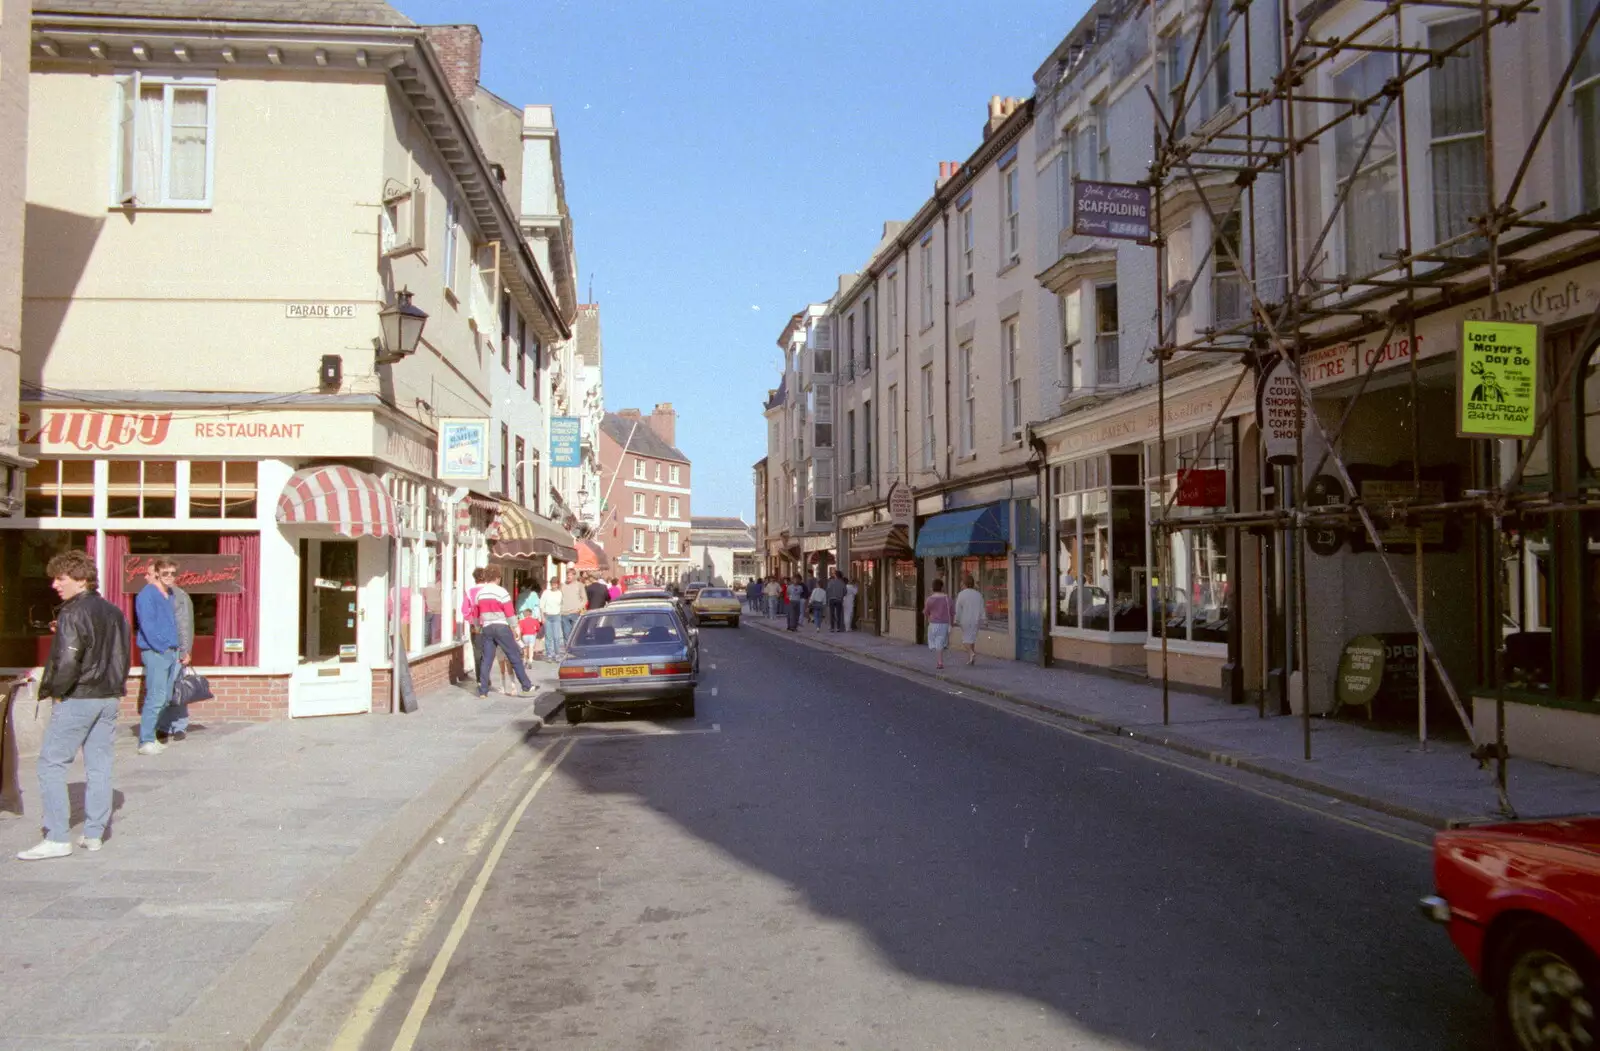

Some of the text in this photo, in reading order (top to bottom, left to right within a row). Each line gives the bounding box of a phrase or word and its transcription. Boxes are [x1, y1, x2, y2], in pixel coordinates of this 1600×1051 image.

[1078, 199, 1146, 217] SCAFFOLDING
[290, 305, 353, 316] PARADE OPE
[1468, 332, 1496, 342] Lord
[1474, 343, 1523, 355] Mayor's
[1485, 355, 1531, 366] Day 86
[1274, 376, 1297, 386] MITR
[1269, 387, 1298, 396] COUR
[1265, 397, 1309, 408] SHOPPG
[1467, 403, 1530, 414] SATURDAY
[1147, 400, 1213, 429] Boksellers
[1468, 411, 1529, 422] 24th MAY
[195, 423, 305, 438] RESTAURANT
